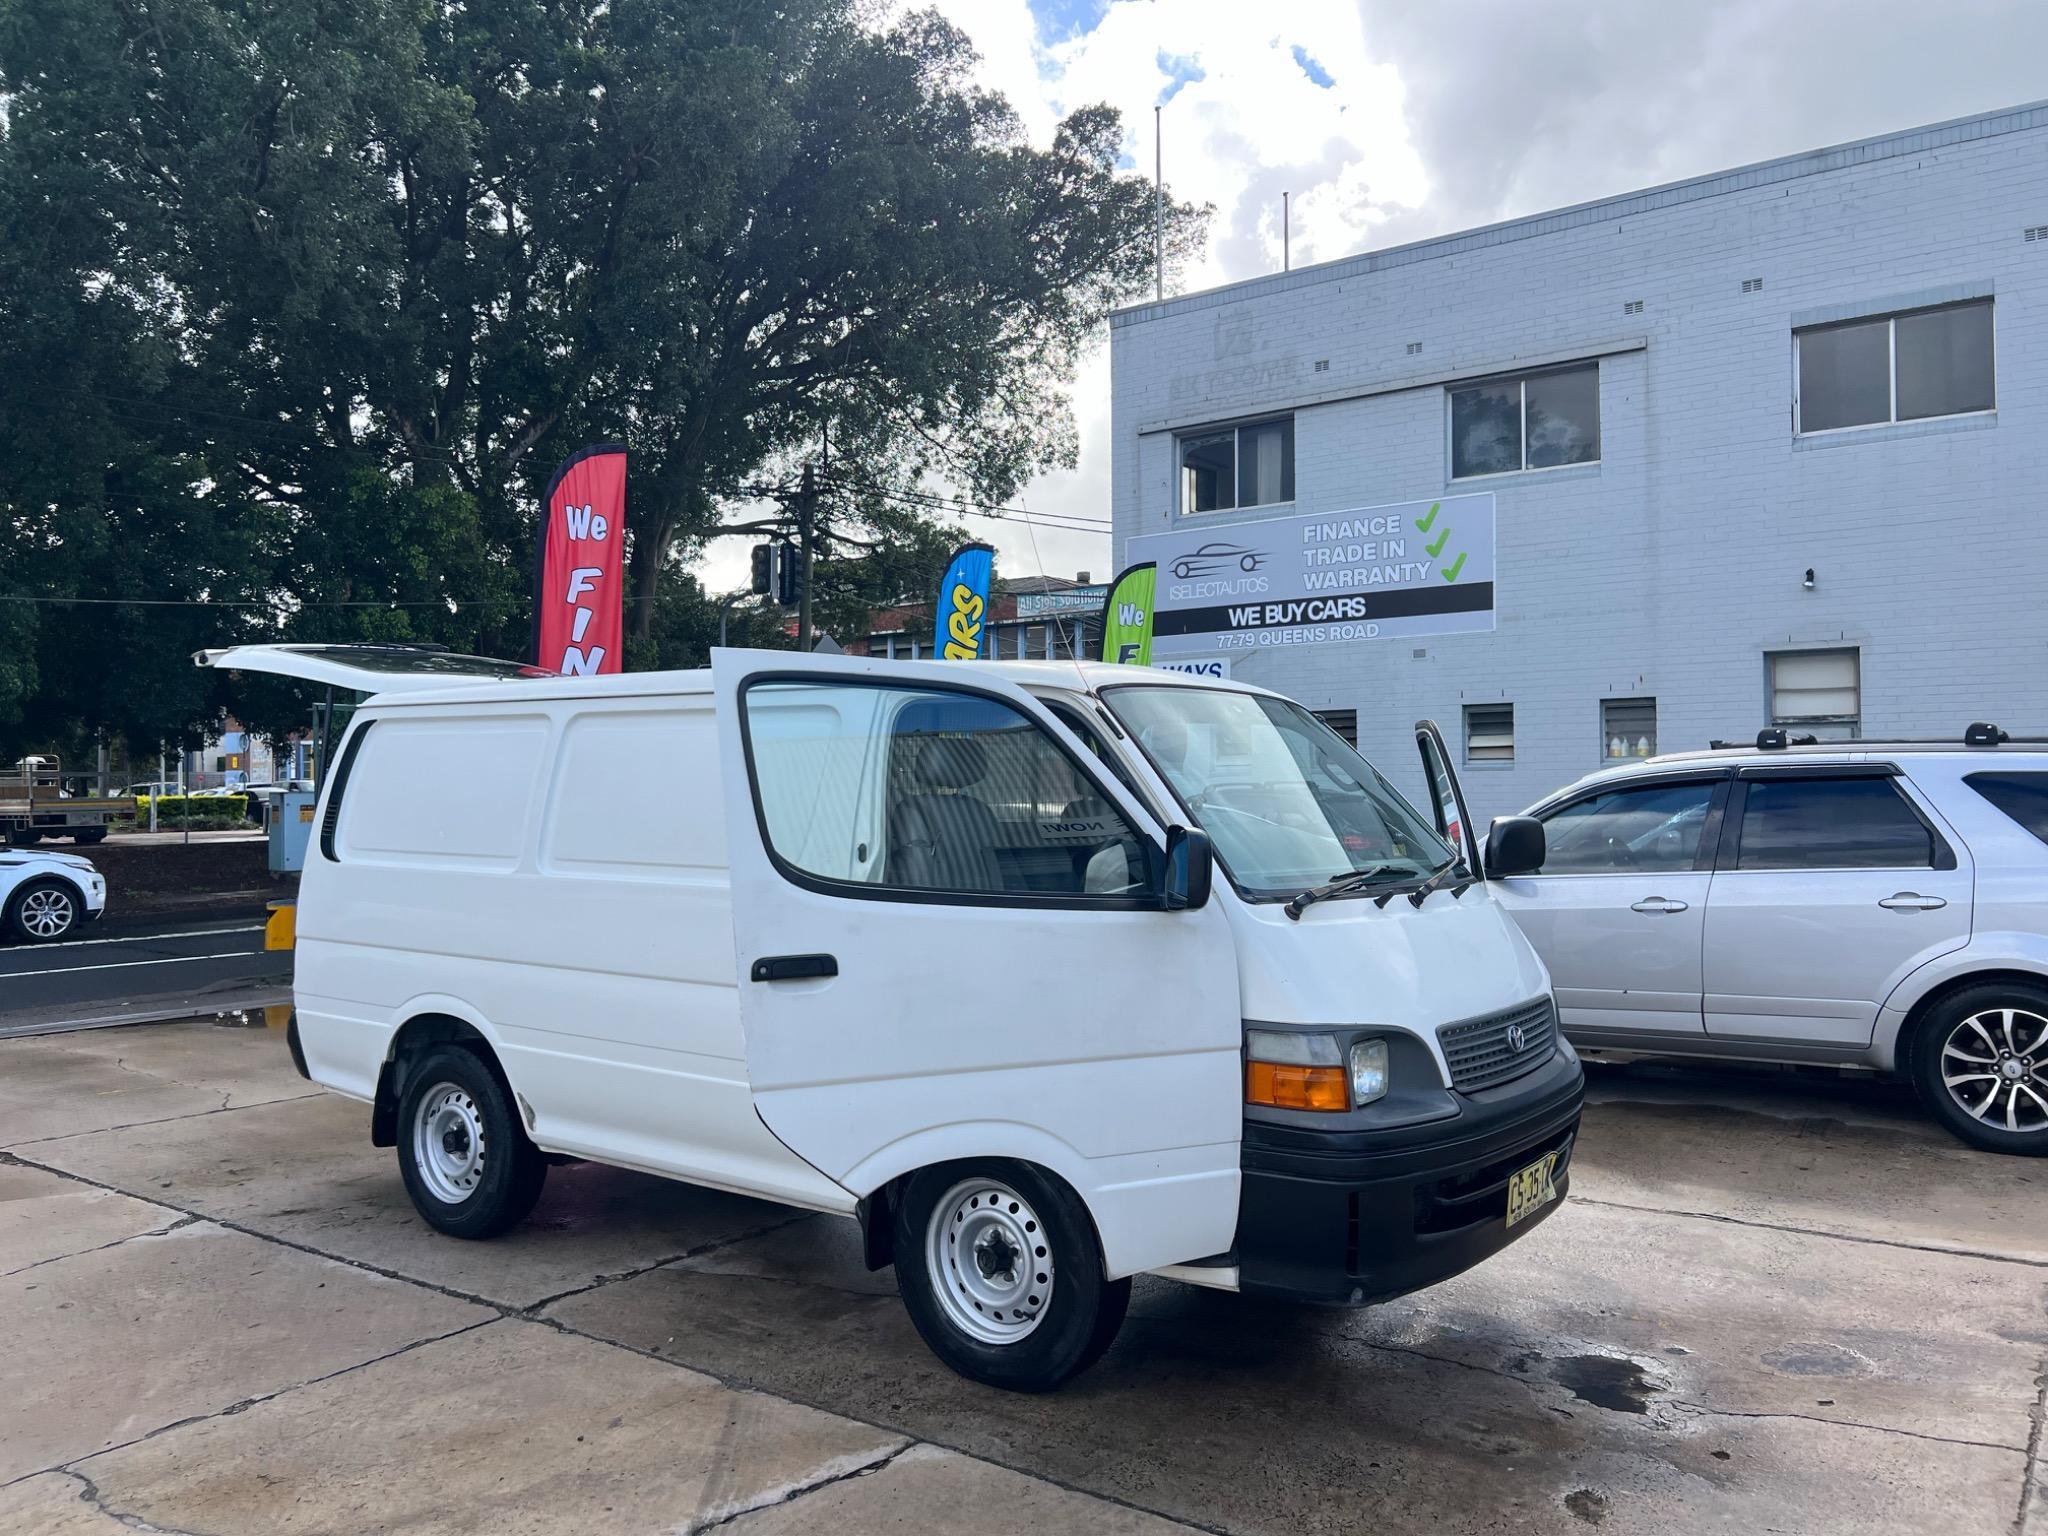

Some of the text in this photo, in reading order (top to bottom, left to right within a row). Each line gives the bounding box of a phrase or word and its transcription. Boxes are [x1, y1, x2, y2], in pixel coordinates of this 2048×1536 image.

[565, 504, 608, 542] We
[1303, 514, 1402, 544] FINANCE
[1303, 538, 1406, 568] TRADE IN
[1169, 576, 1269, 600] ISELECTAUTOS
[1303, 560, 1433, 592] WARRANTY
[1019, 595, 1033, 611] All
[1034, 594, 1056, 609] Sign
[1058, 589, 1105, 607] Solutions
[1228, 597, 1366, 627] WE BUY CARS
[1118, 602, 1145, 627] We
[1216, 622, 1380, 649] 77-79 QUEENS ROAD
[1162, 662, 1222, 678] AYS
